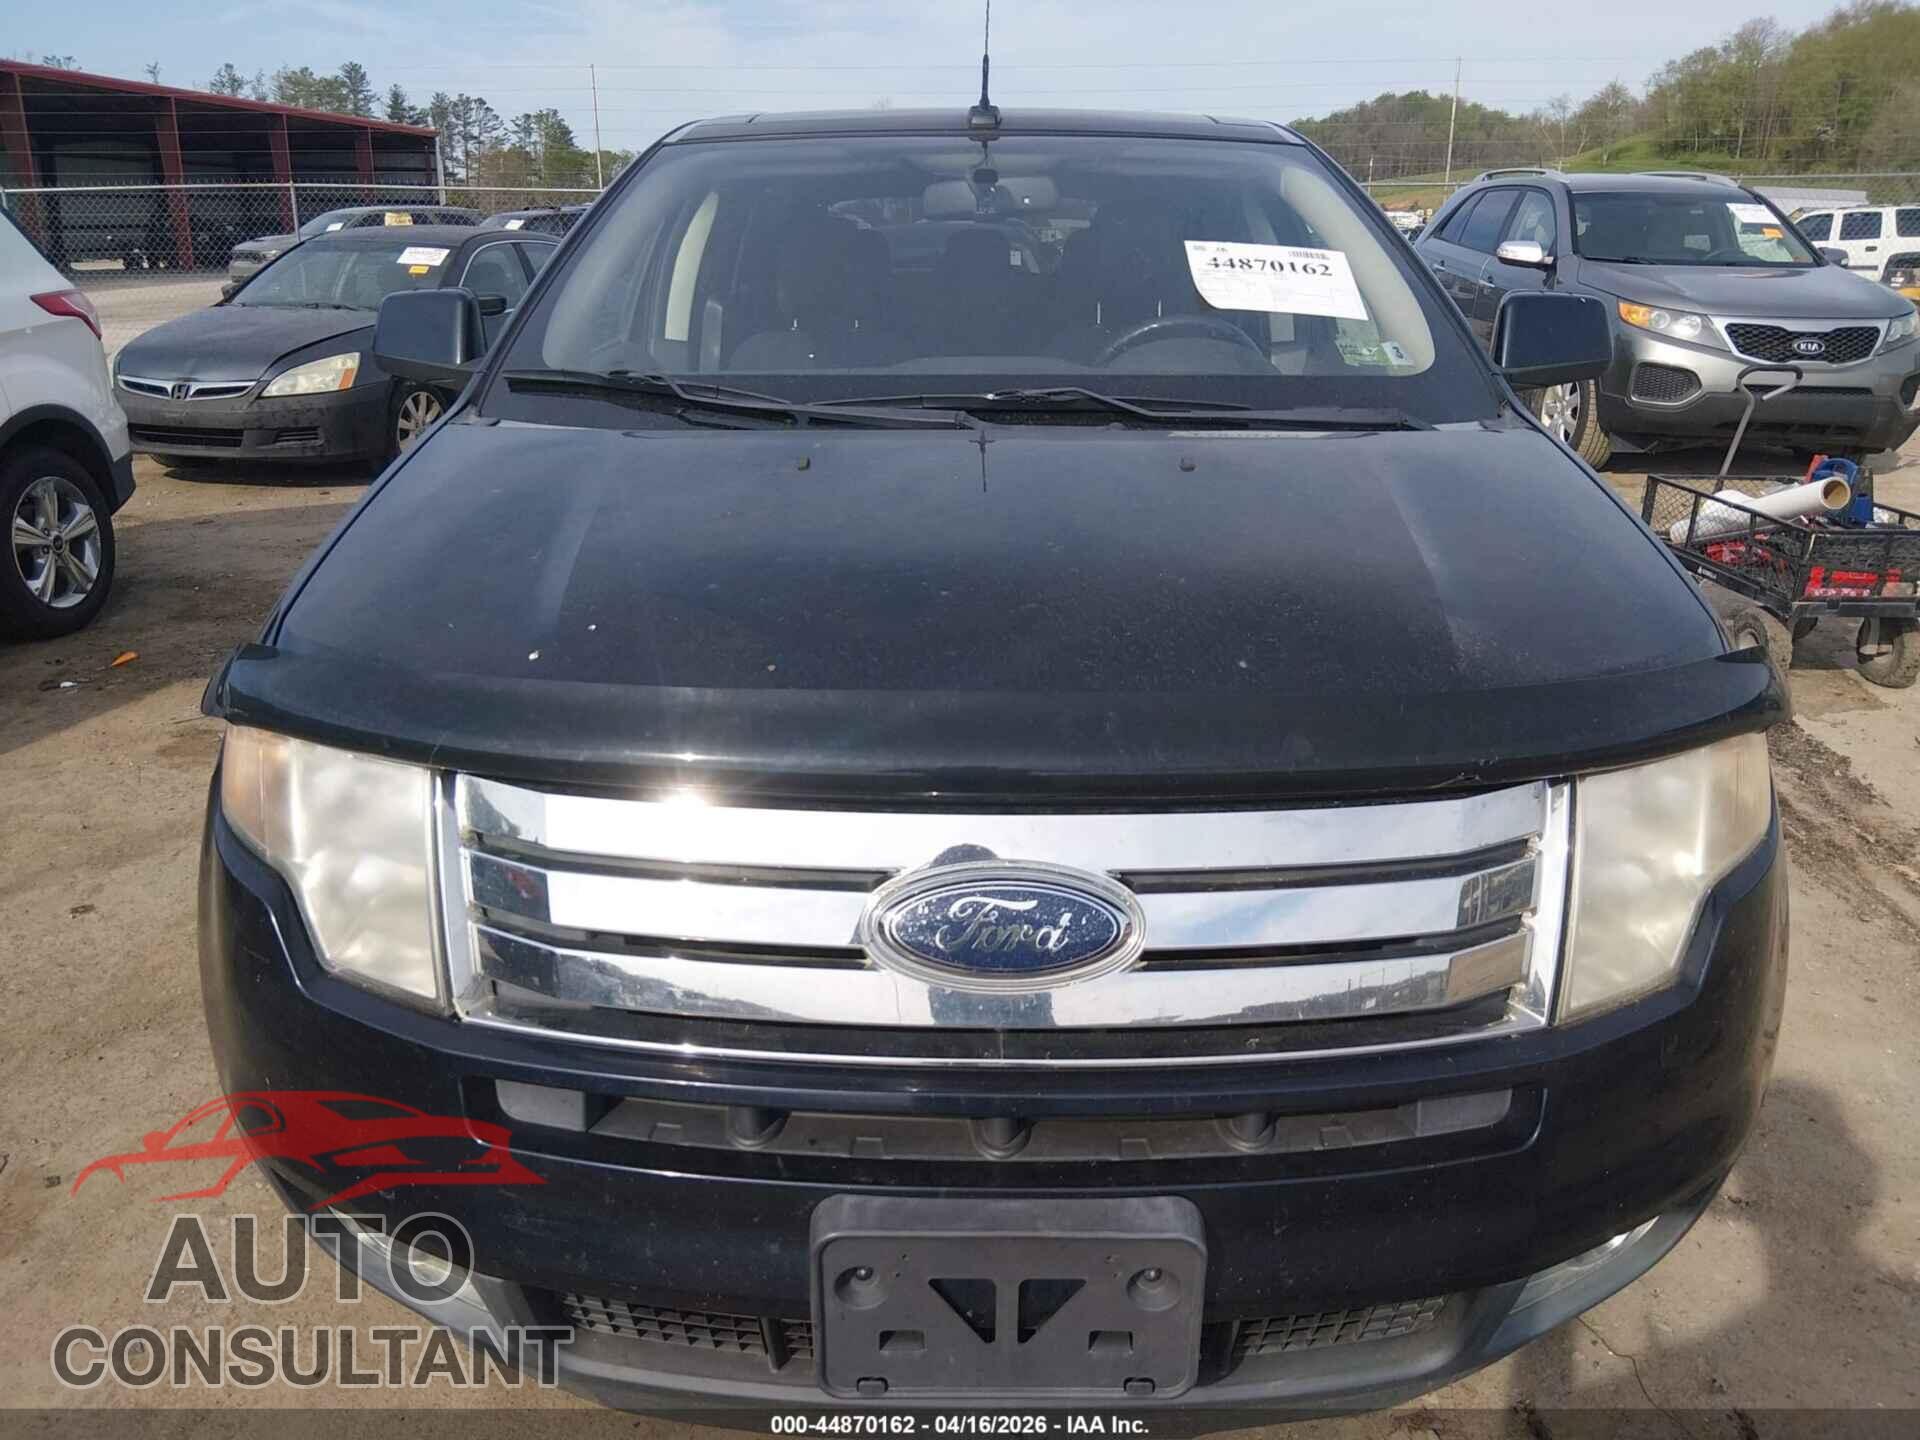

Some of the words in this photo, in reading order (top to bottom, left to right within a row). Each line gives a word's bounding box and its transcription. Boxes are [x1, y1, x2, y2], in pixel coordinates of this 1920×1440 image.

[1206, 256, 1334, 277] 44870162
[1799, 343, 1819, 351] KIA
[935, 896, 1074, 952] Ford
